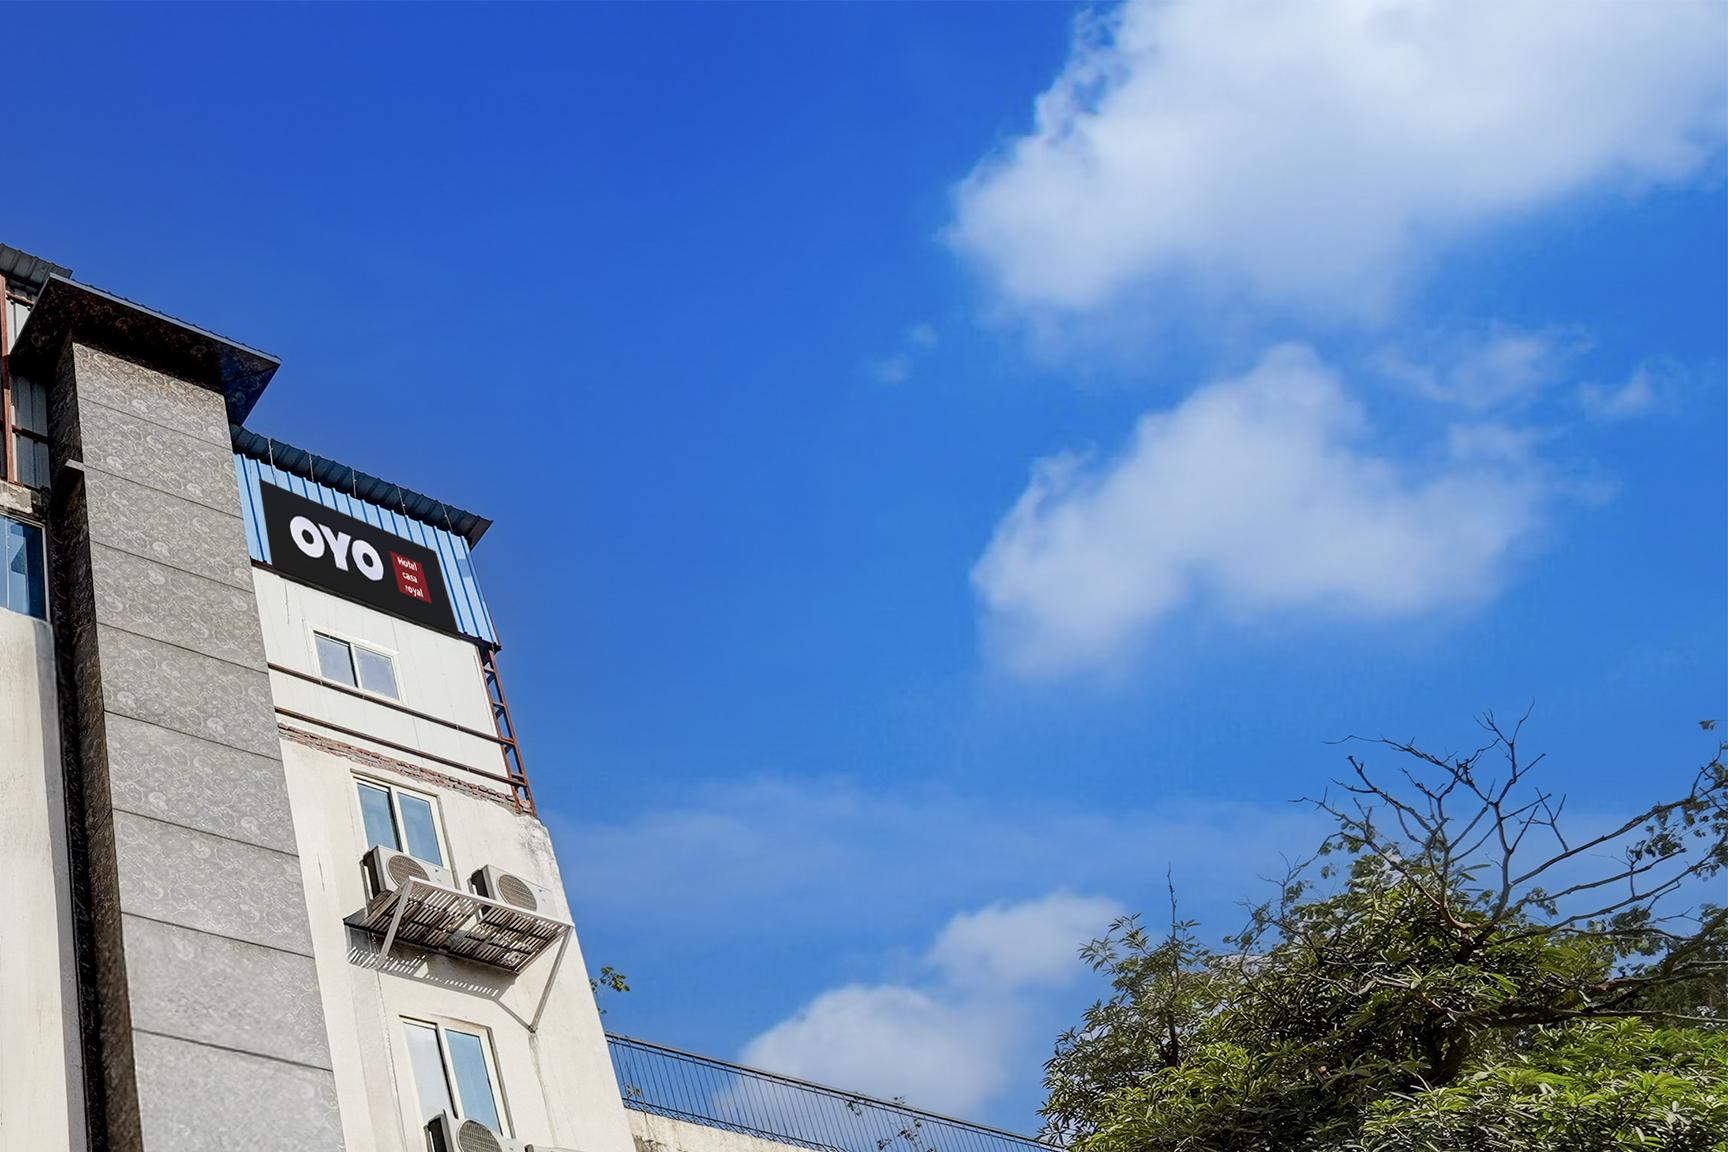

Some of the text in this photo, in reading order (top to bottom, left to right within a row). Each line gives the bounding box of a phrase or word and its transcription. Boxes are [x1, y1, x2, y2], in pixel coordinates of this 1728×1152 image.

[289, 515, 384, 581] OYO
[397, 556, 418, 572] Hotel
[402, 572, 418, 583] casa
[405, 585, 424, 598] royal
